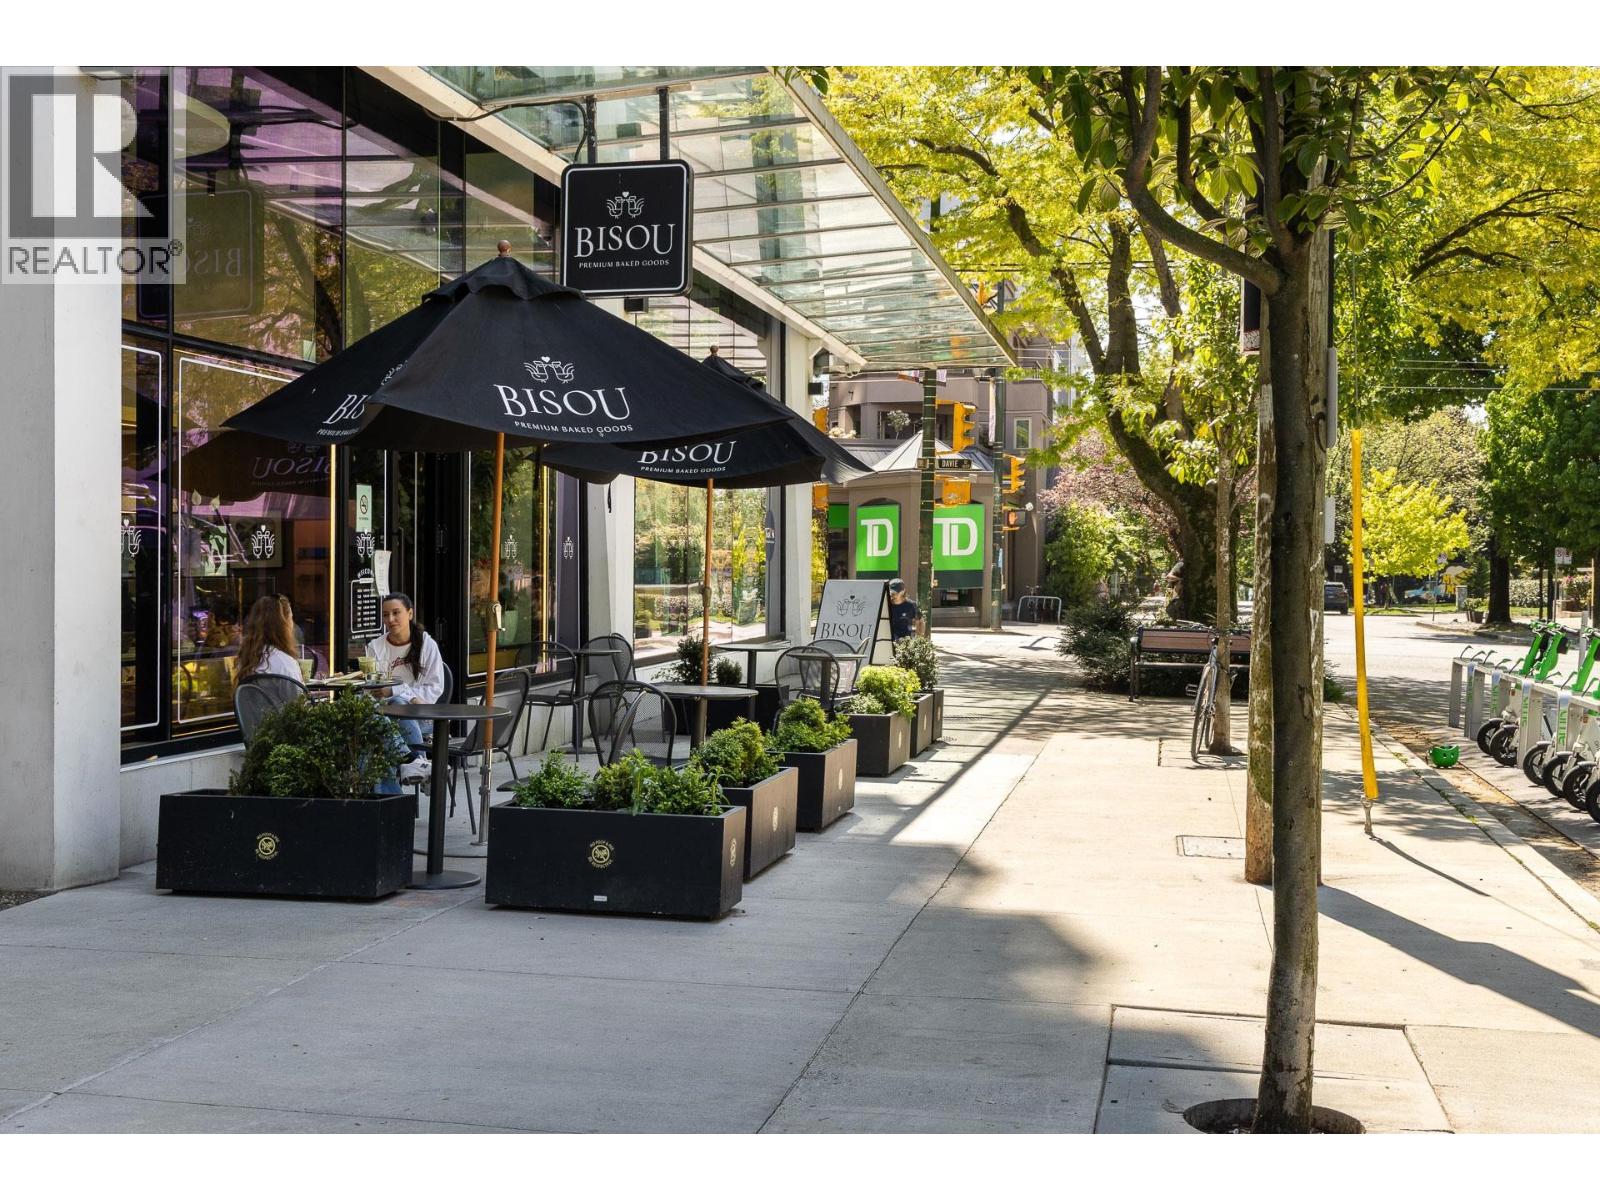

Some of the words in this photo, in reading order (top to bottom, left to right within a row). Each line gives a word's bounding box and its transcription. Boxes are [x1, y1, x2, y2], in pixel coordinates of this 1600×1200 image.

[574, 223, 677, 258] BISOU
[493, 384, 631, 421] BISOU
[514, 421, 559, 432] PREMIUM
[562, 425, 594, 434] BAKED
[596, 424, 634, 433] GOODS
[941, 460, 959, 468] DAVIE
[861, 519, 894, 557] TD
[933, 518, 978, 556] TD
[820, 622, 872, 641] BISOU
